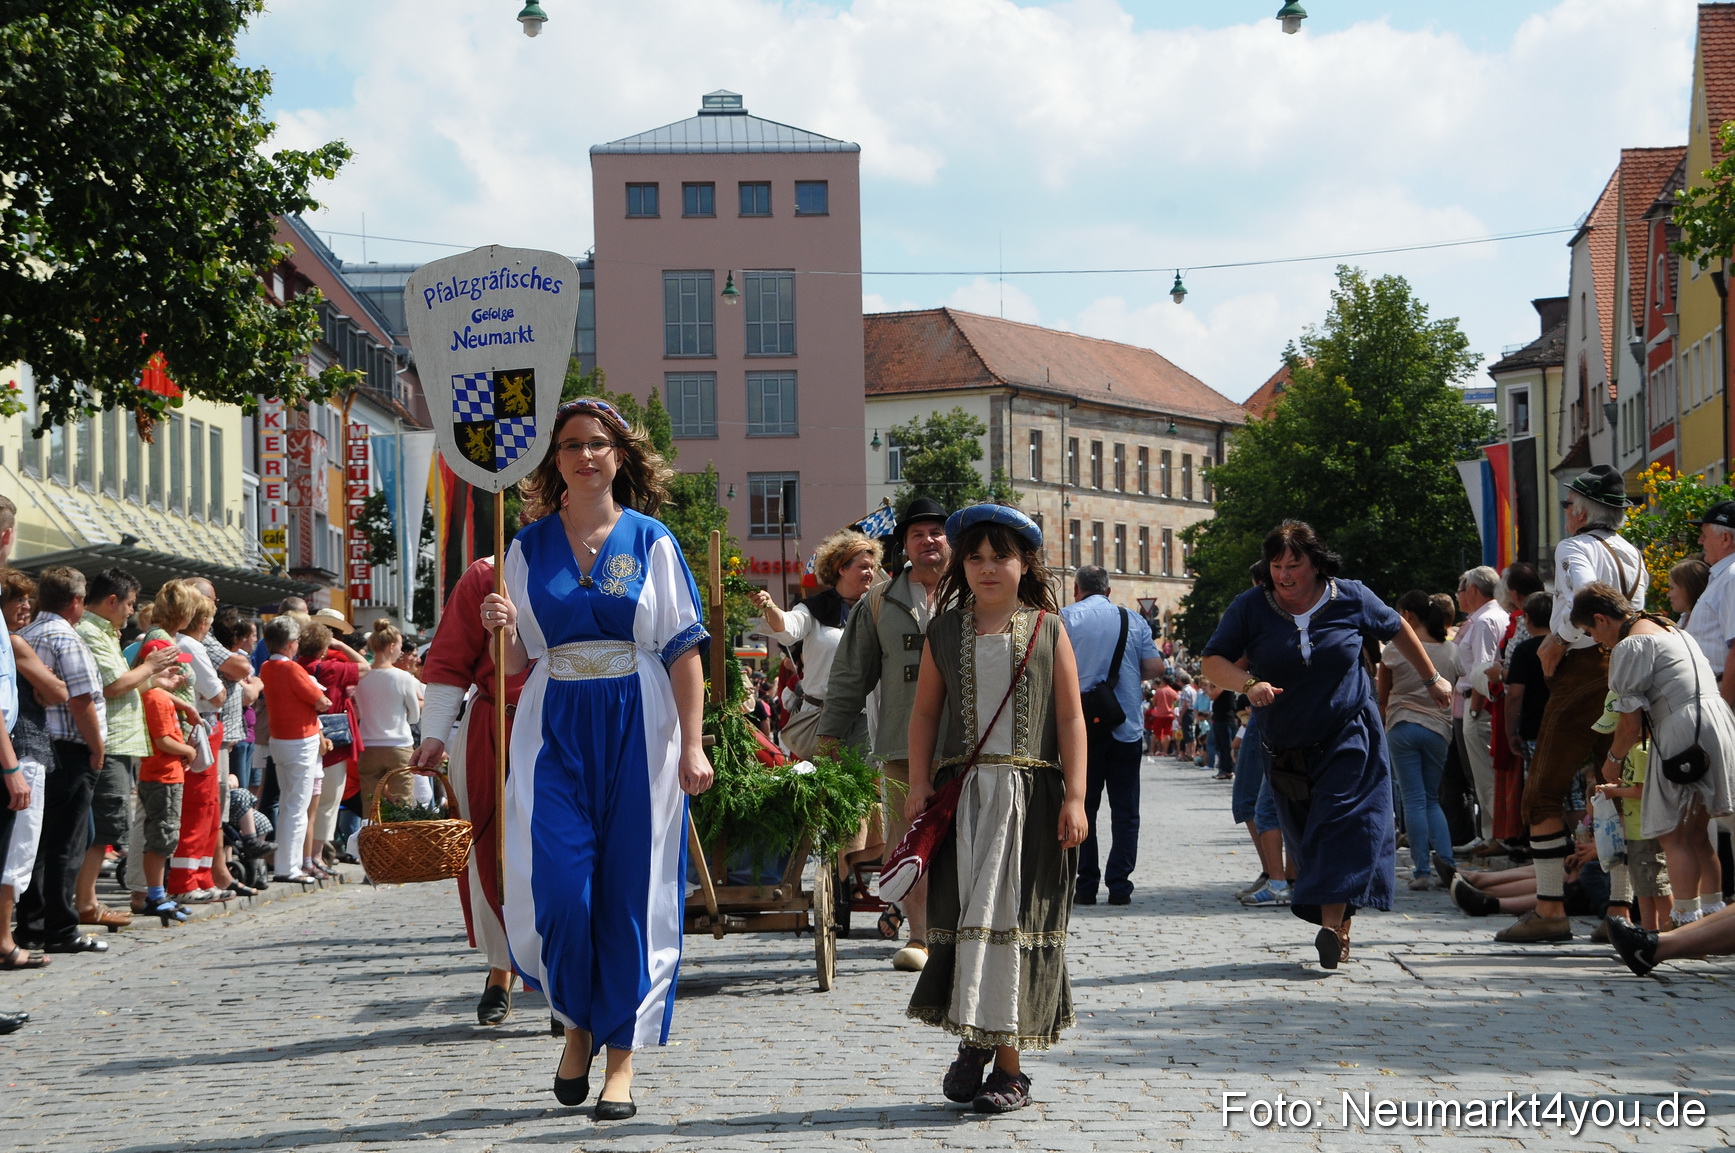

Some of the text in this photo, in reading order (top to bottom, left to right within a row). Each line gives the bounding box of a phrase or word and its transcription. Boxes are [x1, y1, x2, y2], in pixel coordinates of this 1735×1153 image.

[423, 266, 563, 309] Pfalzgräfisches
[471, 307, 514, 324] Gefolge
[451, 325, 535, 351] Neumarkt
[263, 531, 286, 544] café
